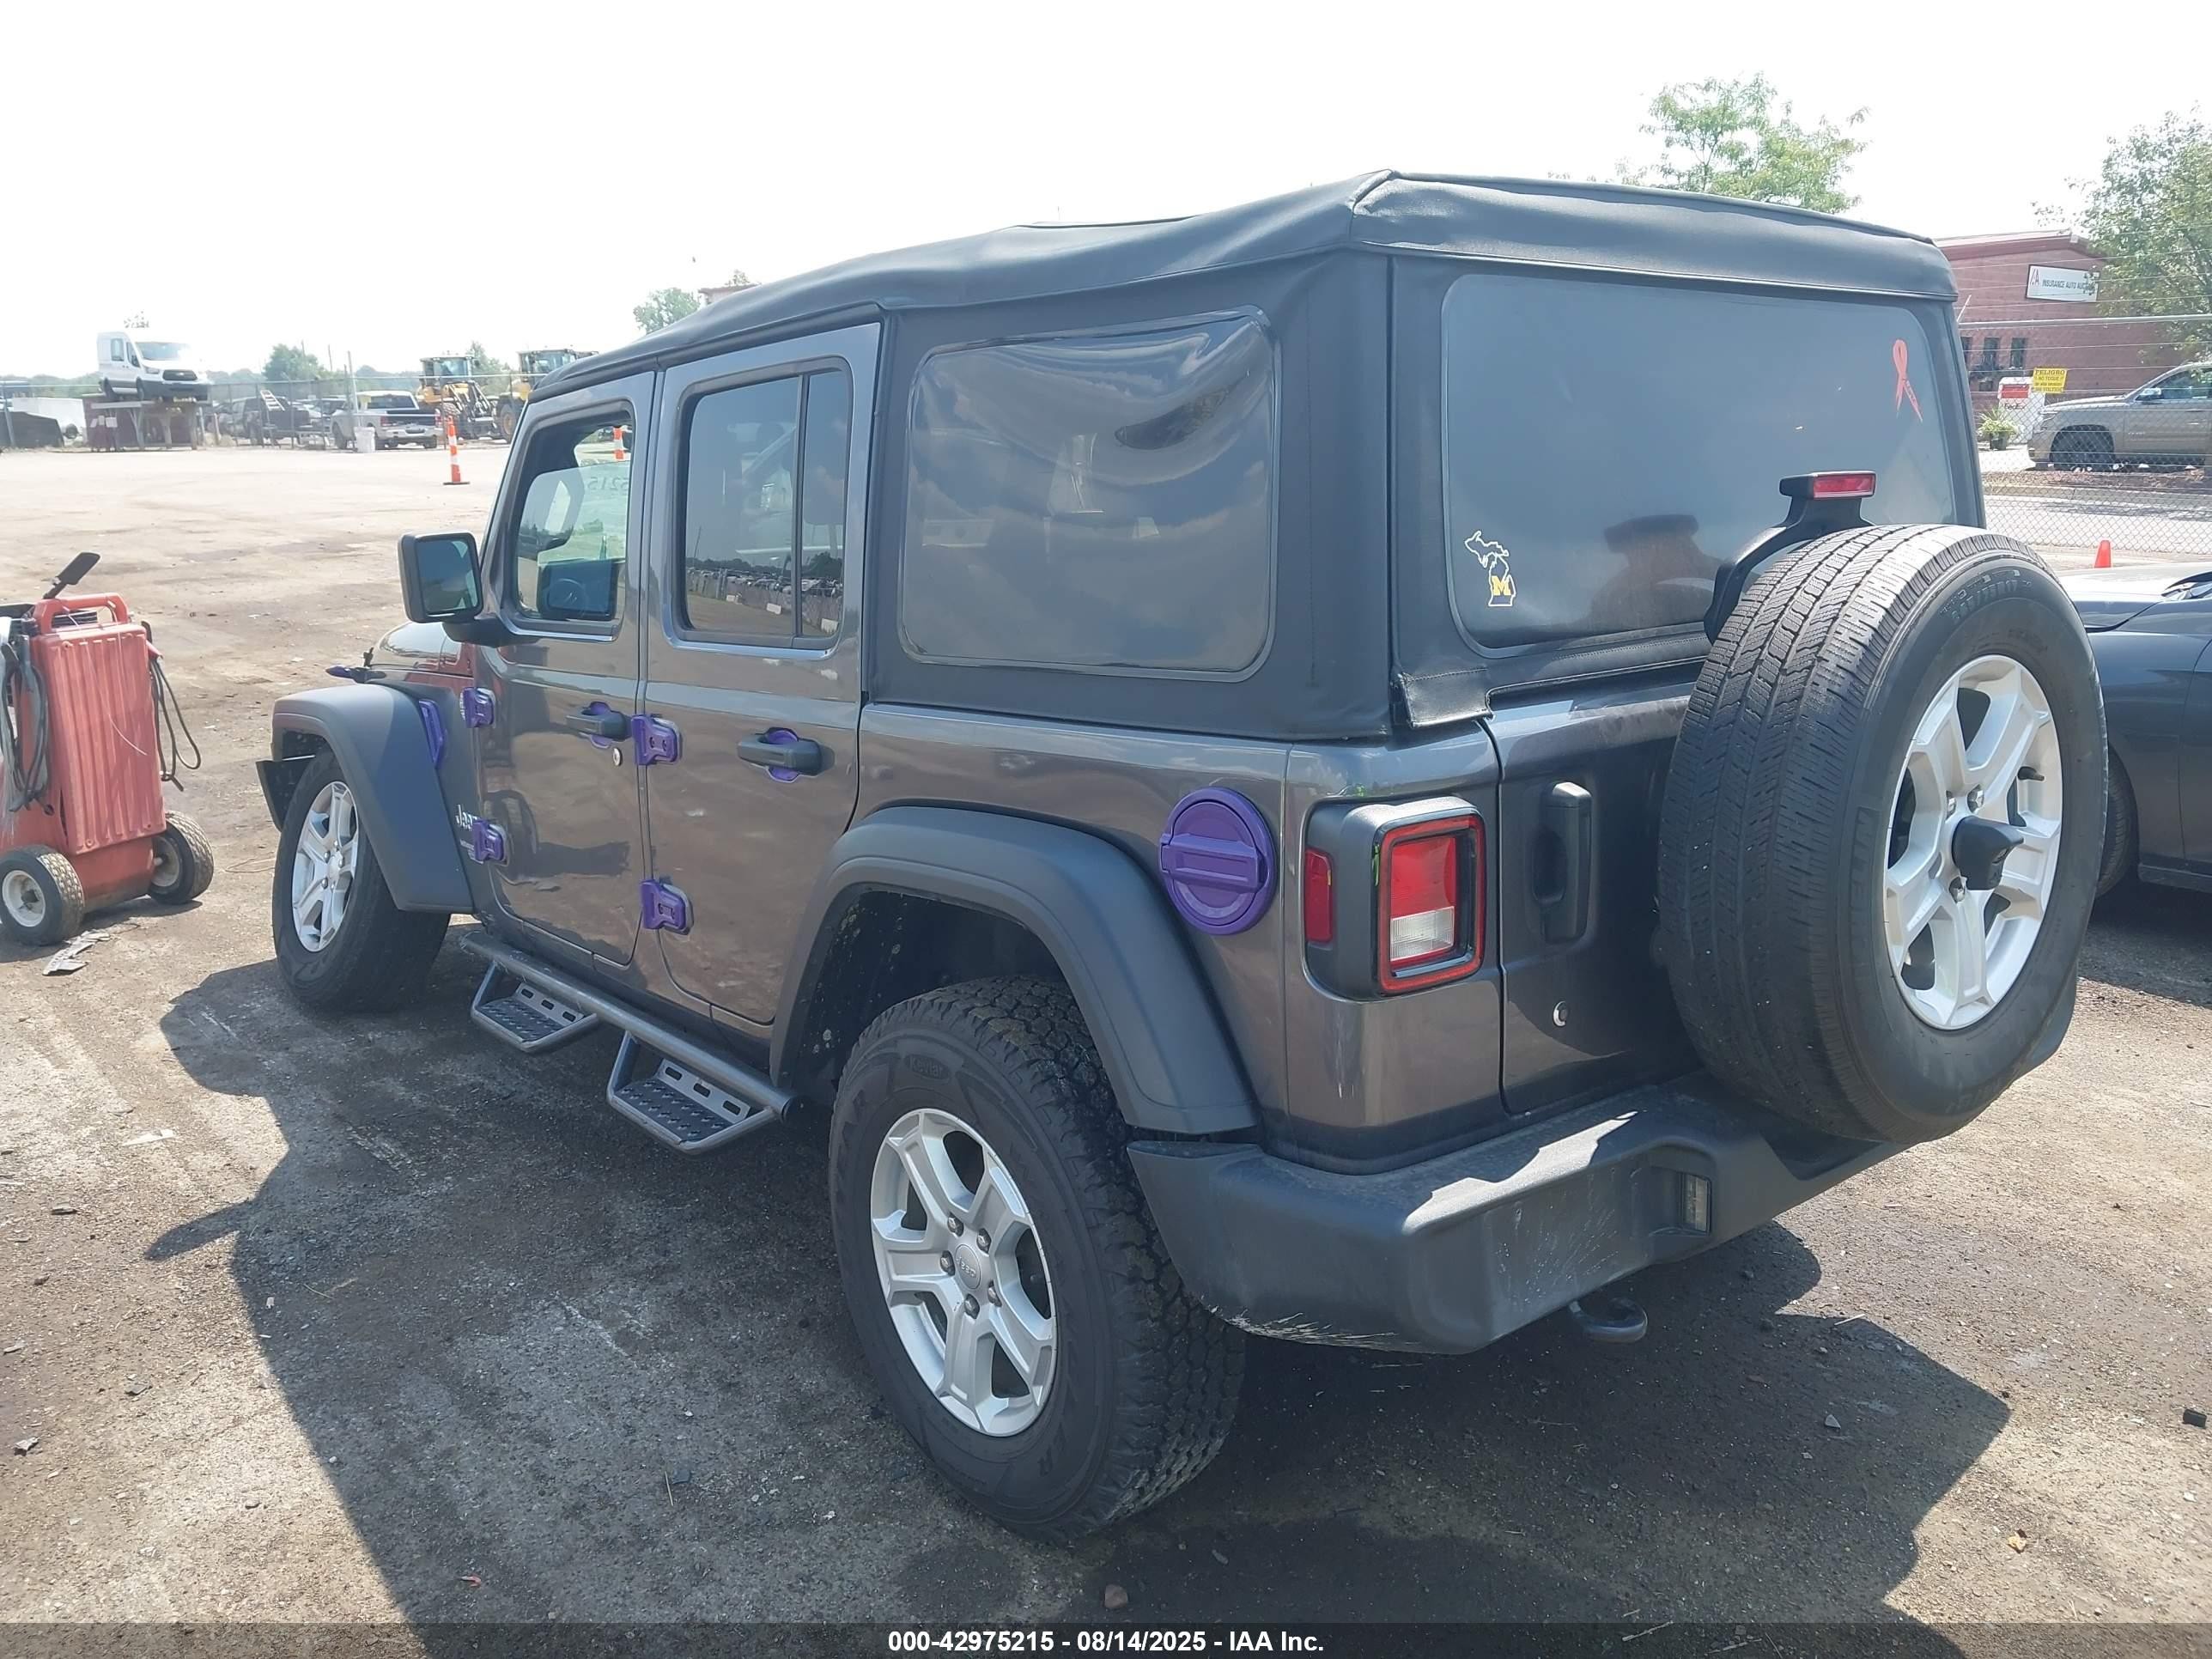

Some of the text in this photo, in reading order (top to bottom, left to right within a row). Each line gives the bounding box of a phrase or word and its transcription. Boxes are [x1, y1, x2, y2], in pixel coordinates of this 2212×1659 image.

[2042, 279, 2065, 289] INSURANCE
[2065, 281, 2076, 289] AUTO
[1491, 575, 1512, 596] M
[455, 804, 477, 831] Jee
